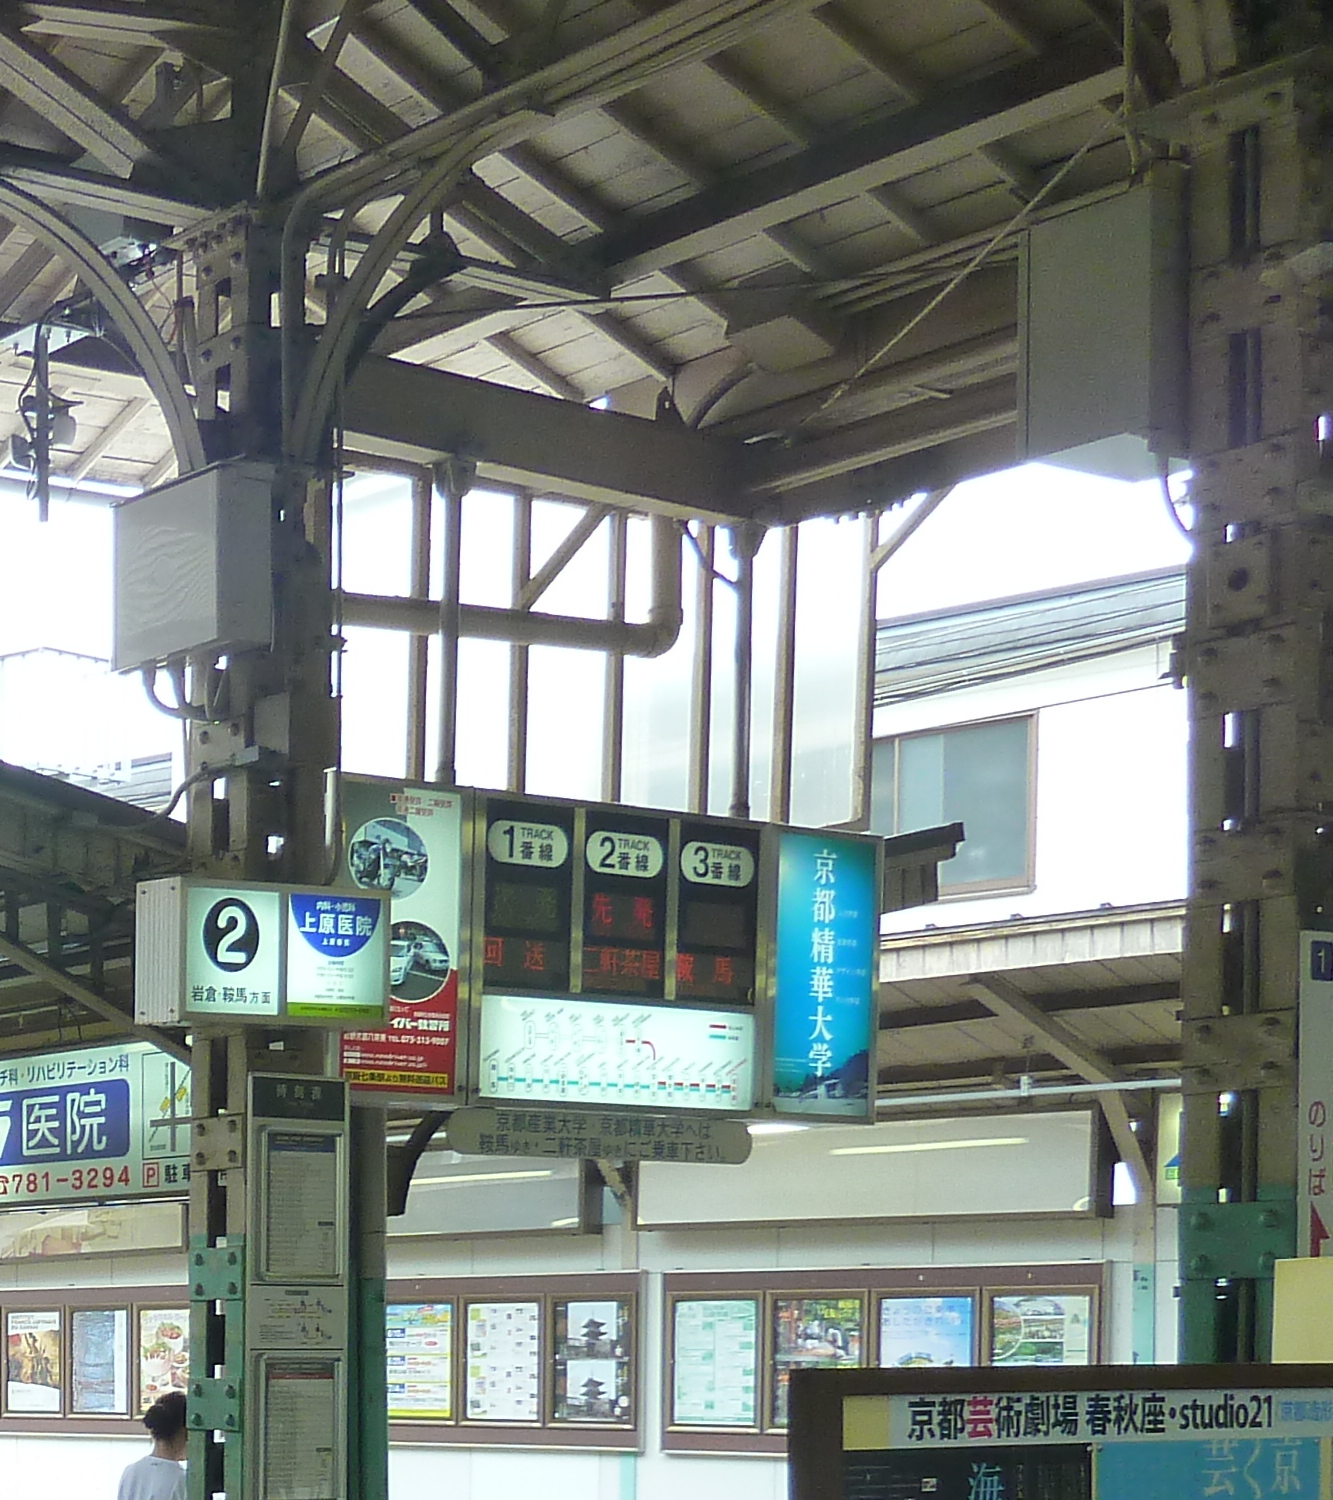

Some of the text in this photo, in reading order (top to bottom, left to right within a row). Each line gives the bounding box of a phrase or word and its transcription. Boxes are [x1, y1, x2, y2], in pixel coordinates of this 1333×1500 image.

[503, 826, 554, 858] 1 TRACK
[519, 841, 554, 862] 番線
[599, 836, 650, 869] 2 TRACK
[617, 852, 650, 872] 番線
[693, 846, 742, 878] 3 TRACK
[710, 862, 742, 881] 番線
[217, 906, 248, 964] 2
[299, 911, 373, 937] 上原医院
[484, 936, 546, 971] 回送
[583, 945, 660, 980] 二軒茶屋
[808, 848, 837, 1078] 京都精華大学
[191, 985, 272, 1005] 岩倉・鞍馬方面
[1308, 1101, 1326, 1196] のりば
[11, 1165, 130, 1195] 781-3294
[907, 1393, 1273, 1442] 京都芸術劇場 春秋座・studio21
